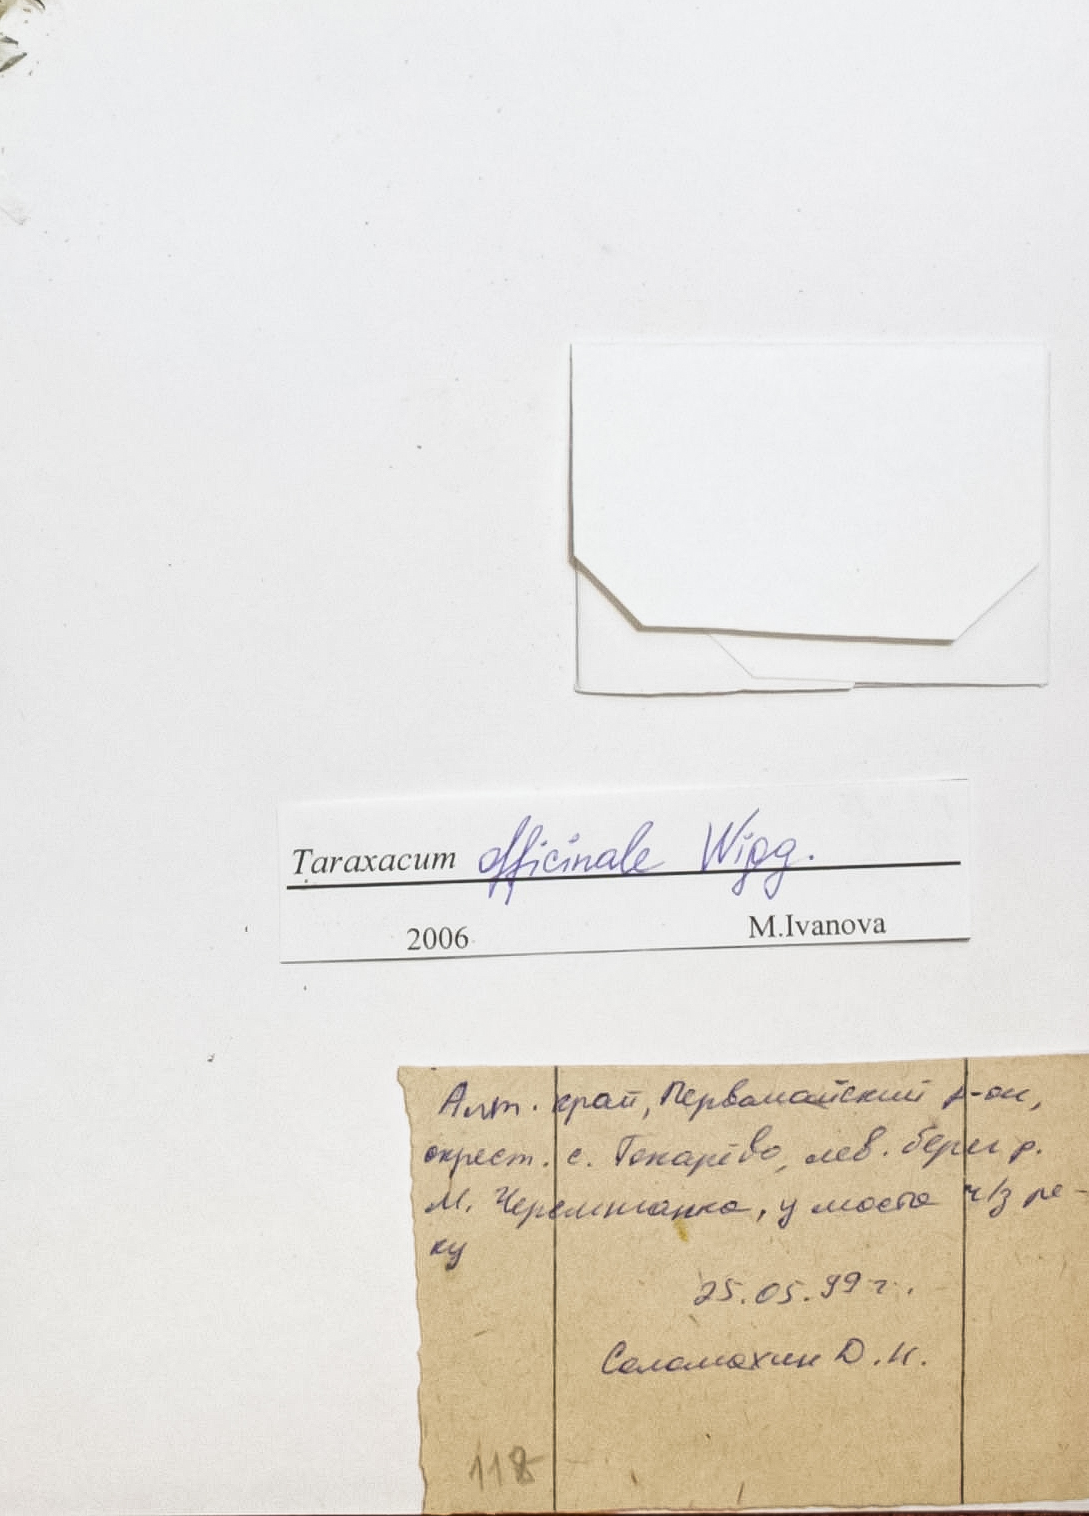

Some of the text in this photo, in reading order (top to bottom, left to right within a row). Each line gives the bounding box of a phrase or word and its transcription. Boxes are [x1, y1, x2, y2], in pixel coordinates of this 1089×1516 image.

[292, 847, 457, 875] Taraxacum
[478, 815, 665, 905] officinale
[406, 914, 887, 951] 2006 M.Ivanova
[438, 1080, 538, 1121] Алт.
[551, 1089, 650, 1125] край,
